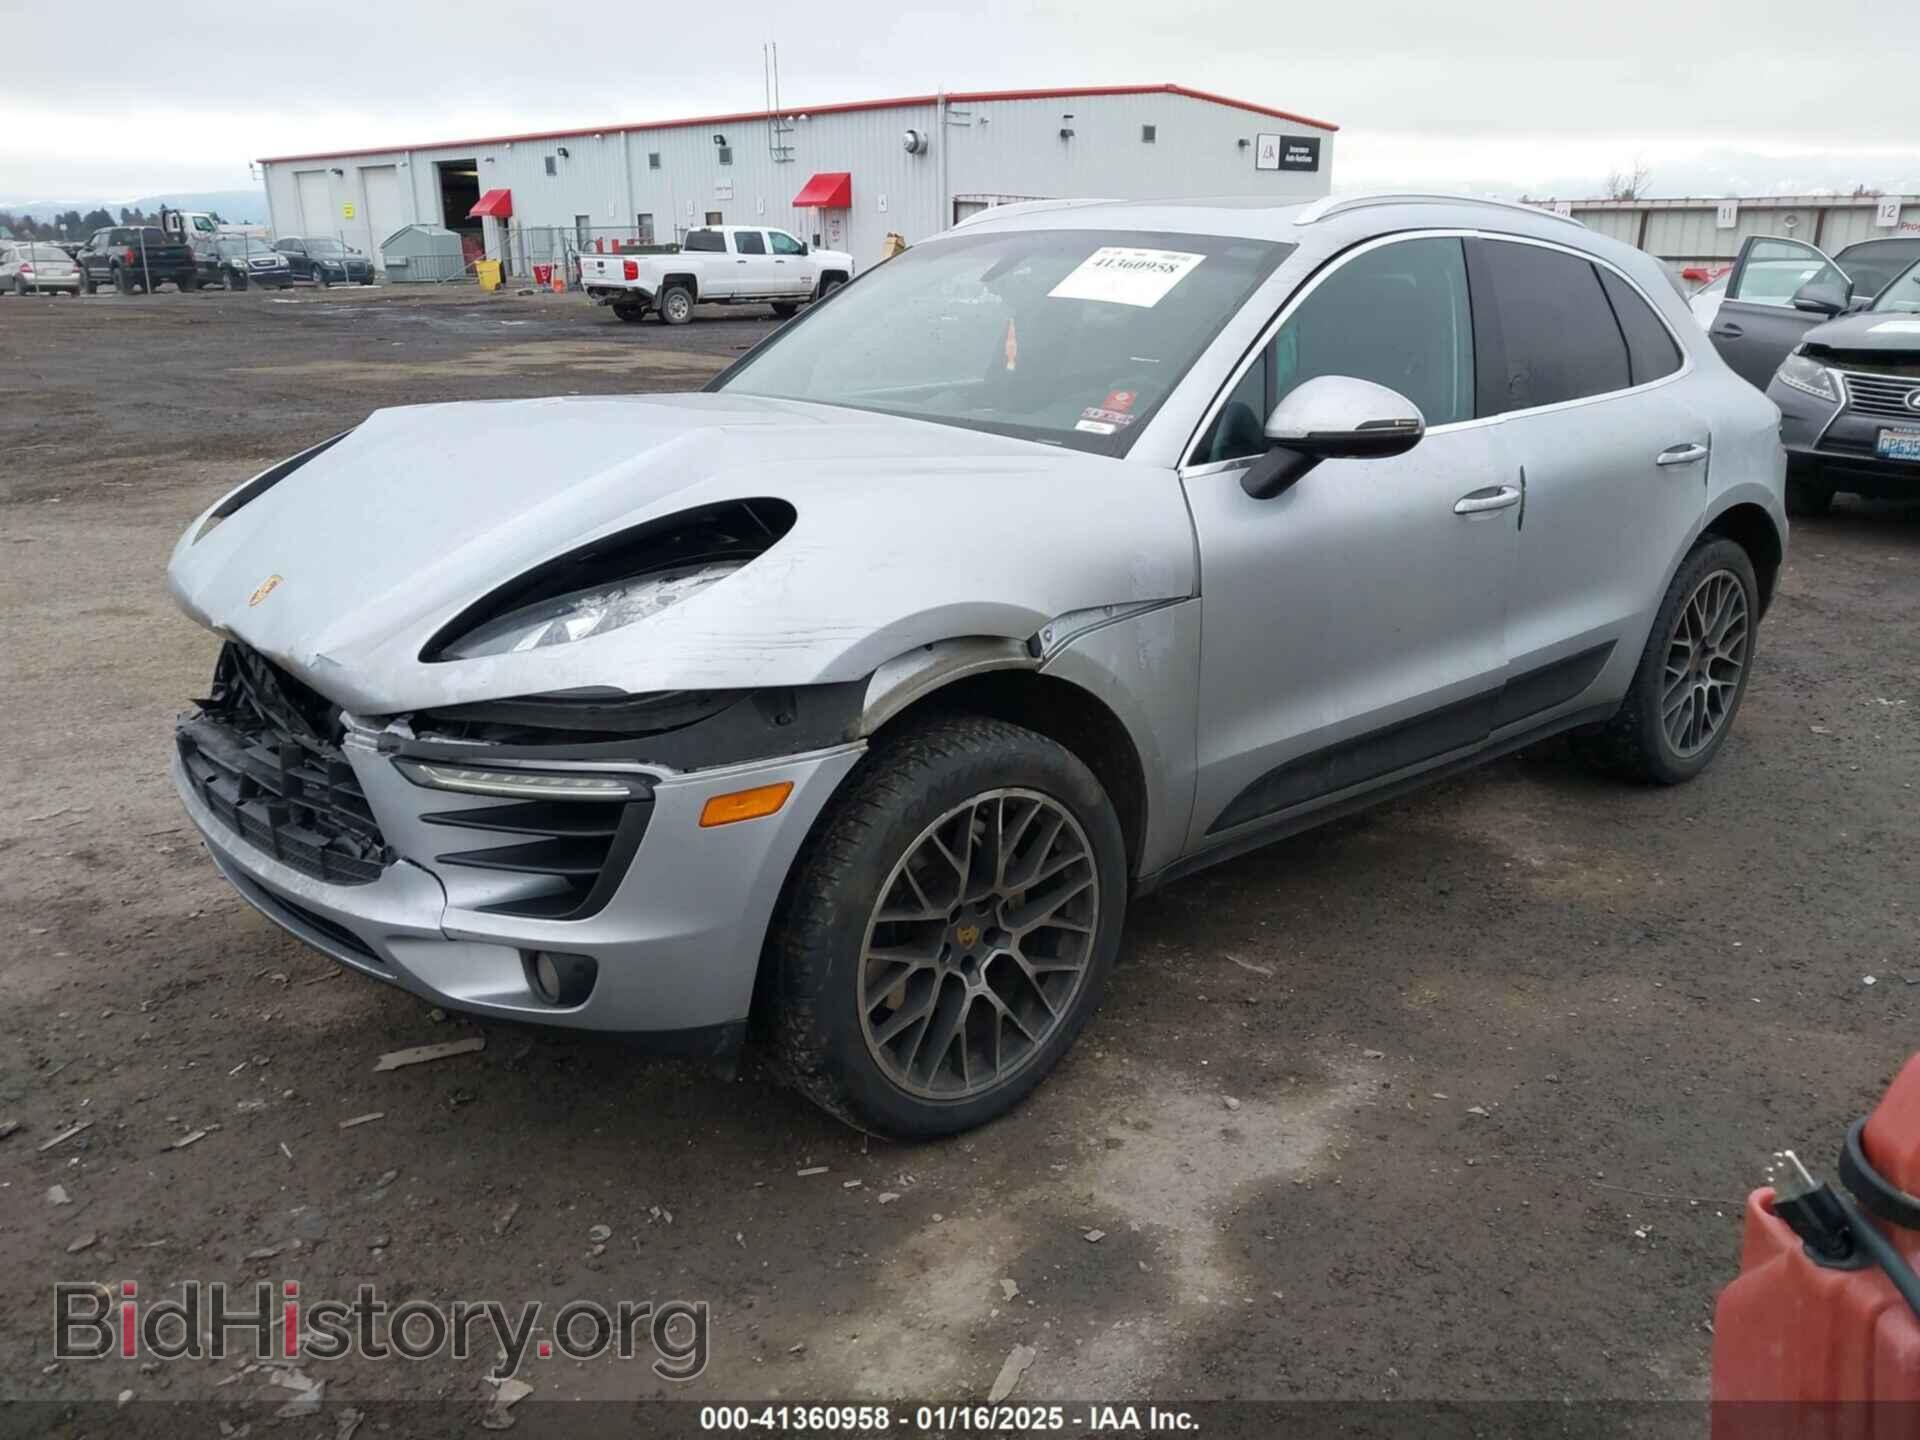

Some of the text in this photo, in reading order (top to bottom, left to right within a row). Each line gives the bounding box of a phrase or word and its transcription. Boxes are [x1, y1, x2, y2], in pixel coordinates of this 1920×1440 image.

[1722, 207, 1732, 221] 11
[1881, 204, 1897, 218] 12
[1093, 258, 1180, 274] 41360958
